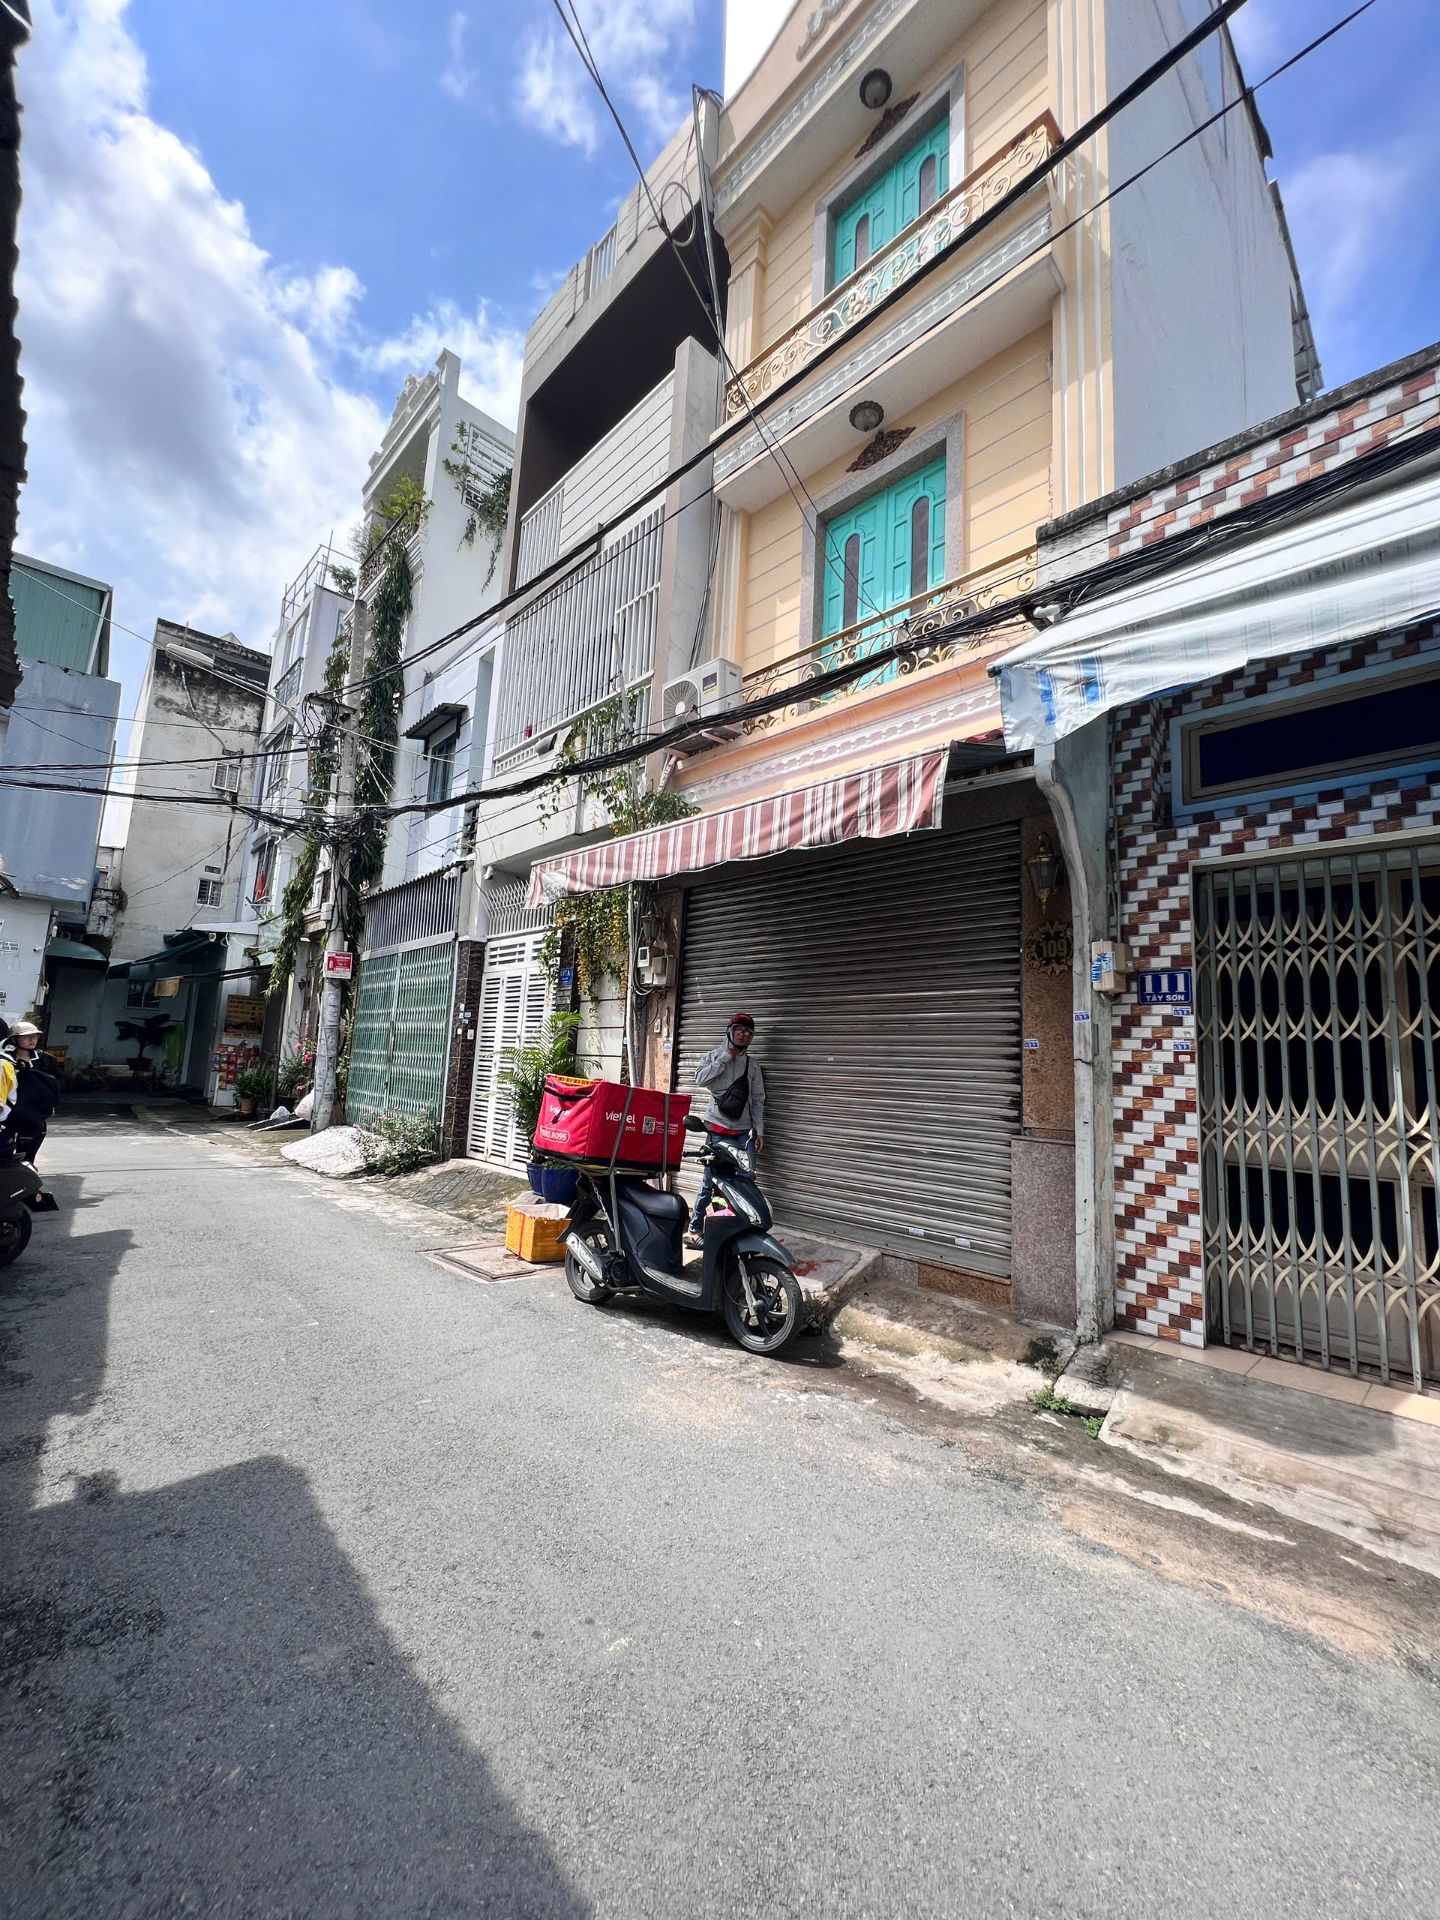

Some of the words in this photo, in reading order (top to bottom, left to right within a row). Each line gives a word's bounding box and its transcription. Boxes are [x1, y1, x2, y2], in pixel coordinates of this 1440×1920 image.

[1041, 941, 1068, 958] 109
[1143, 973, 1187, 993] 111
[605, 1110, 636, 1124] vietel
[540, 1128, 567, 1140] 00.8095
